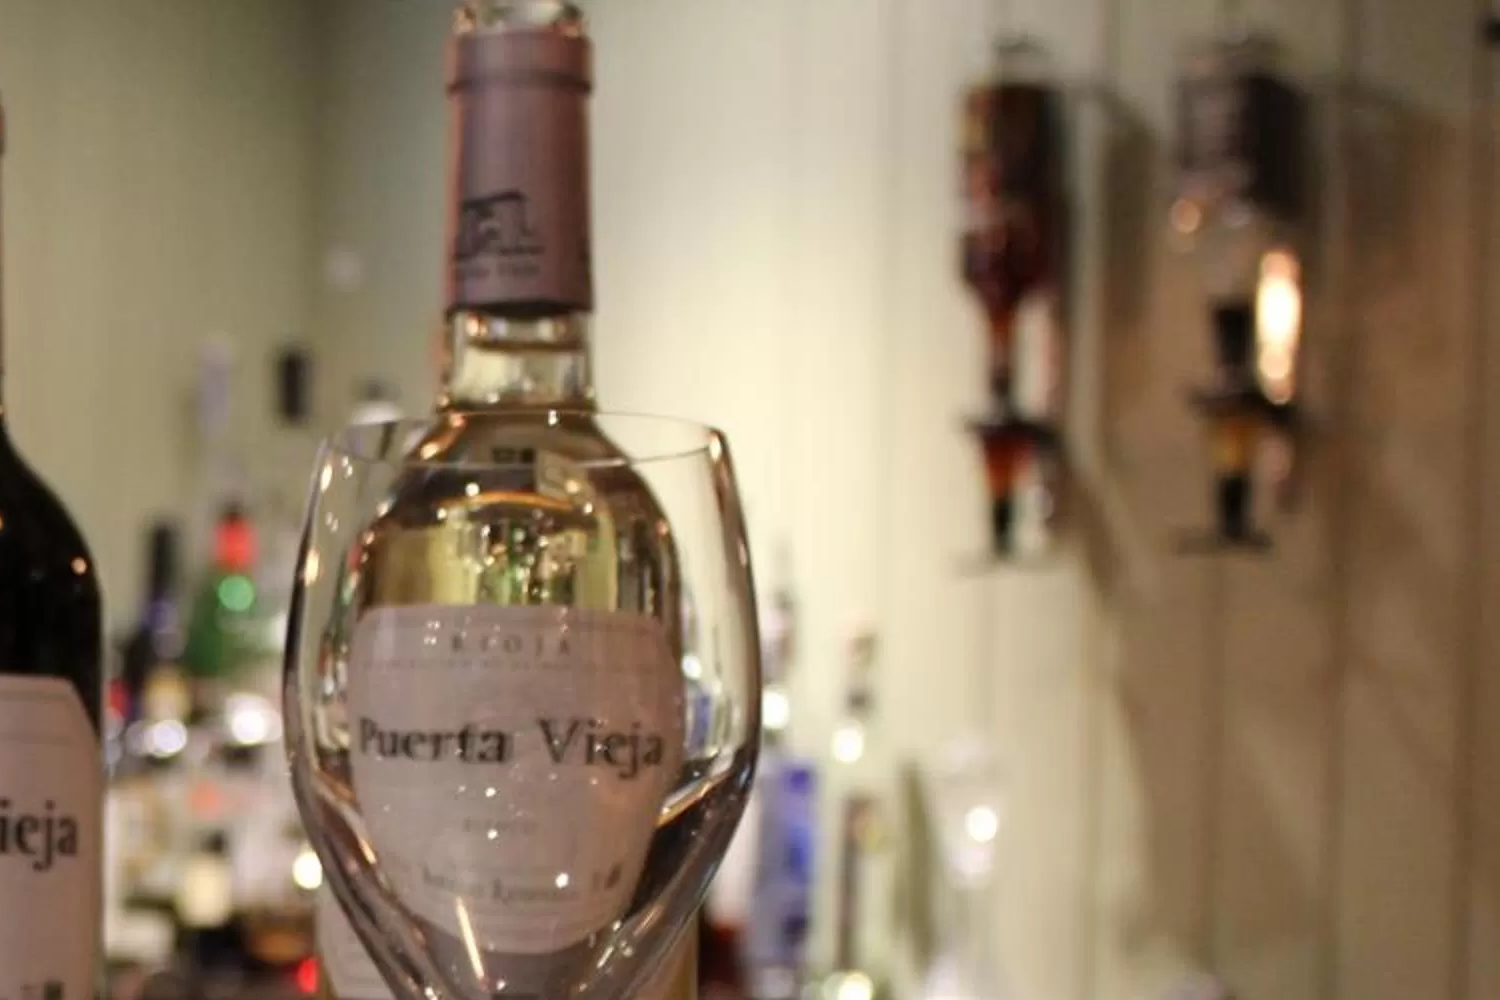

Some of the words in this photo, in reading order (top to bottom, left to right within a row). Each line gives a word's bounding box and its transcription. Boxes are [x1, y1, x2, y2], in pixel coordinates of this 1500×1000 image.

[451, 634, 573, 656] RIOJA
[359, 717, 513, 764] Puerta
[538, 718, 663, 779] Vieja
